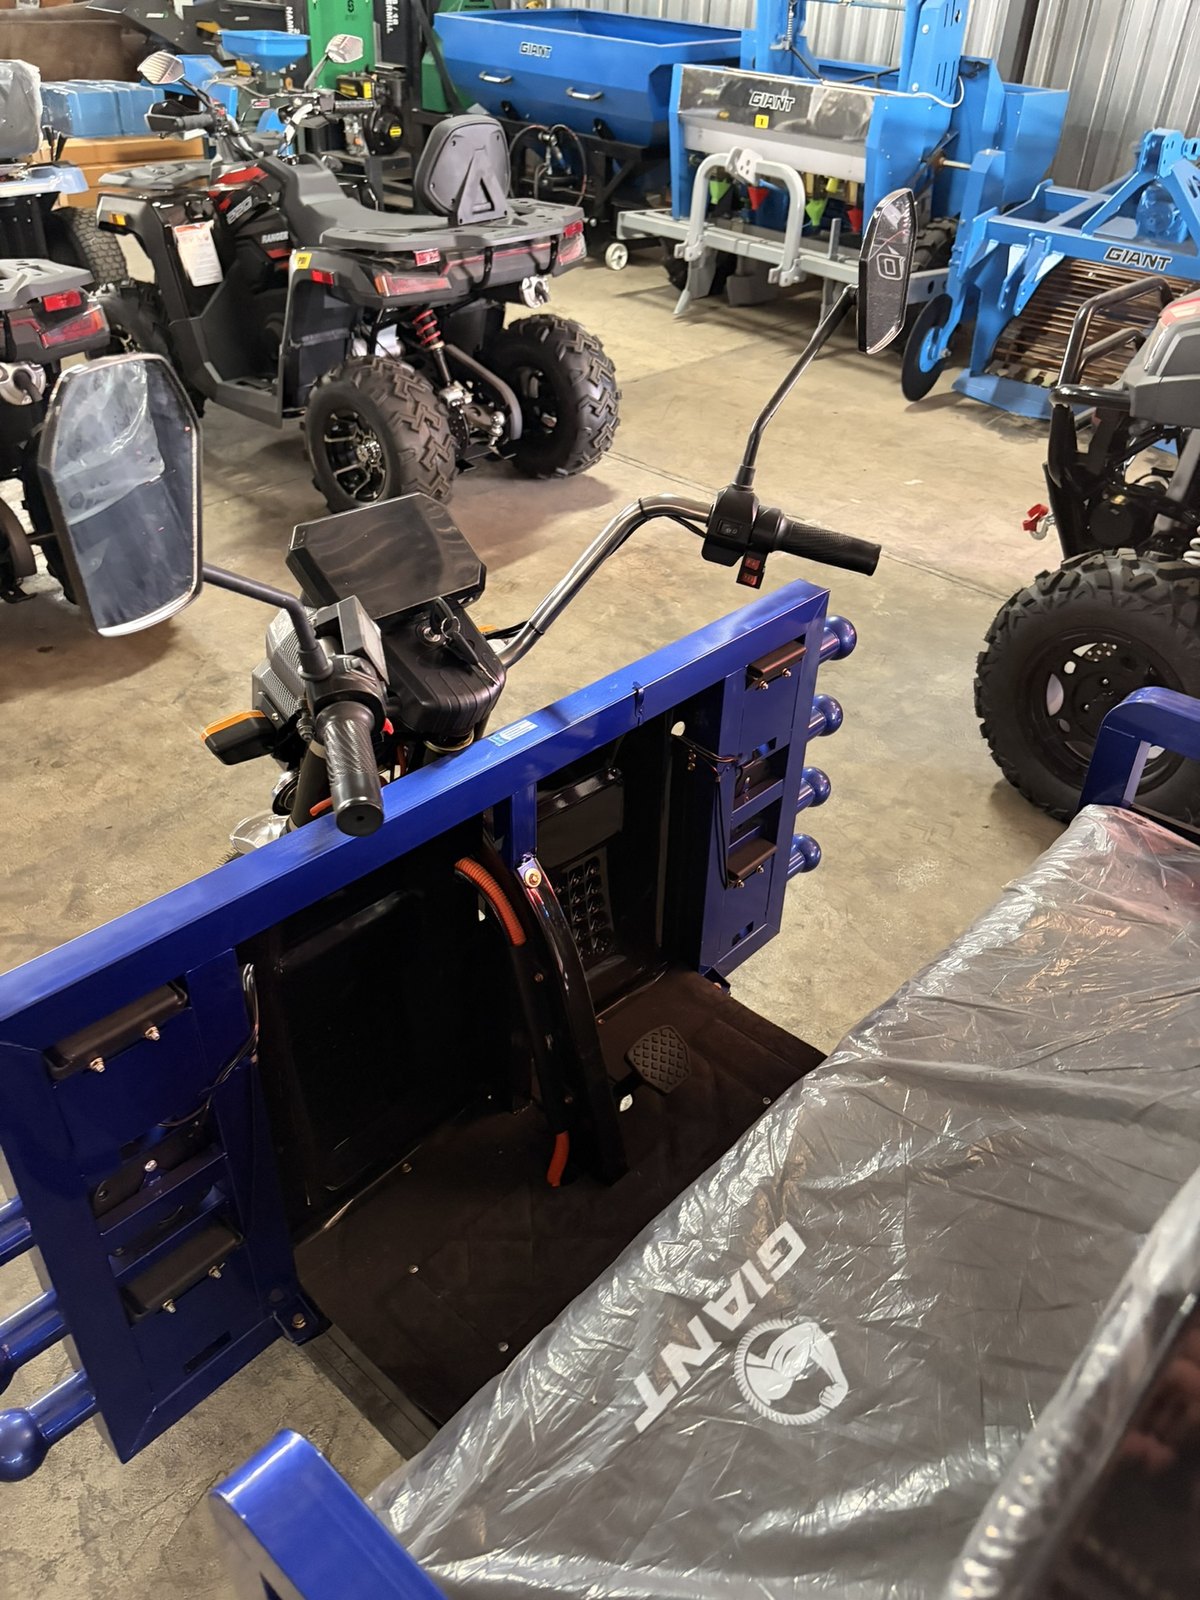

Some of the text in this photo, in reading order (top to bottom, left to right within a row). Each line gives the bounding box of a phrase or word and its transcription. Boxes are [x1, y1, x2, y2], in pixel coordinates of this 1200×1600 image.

[520, 41, 552, 58] GIANT
[749, 91, 795, 112] GIANT
[1104, 246, 1173, 271] GIANT
[633, 1220, 807, 1434] GIANT
